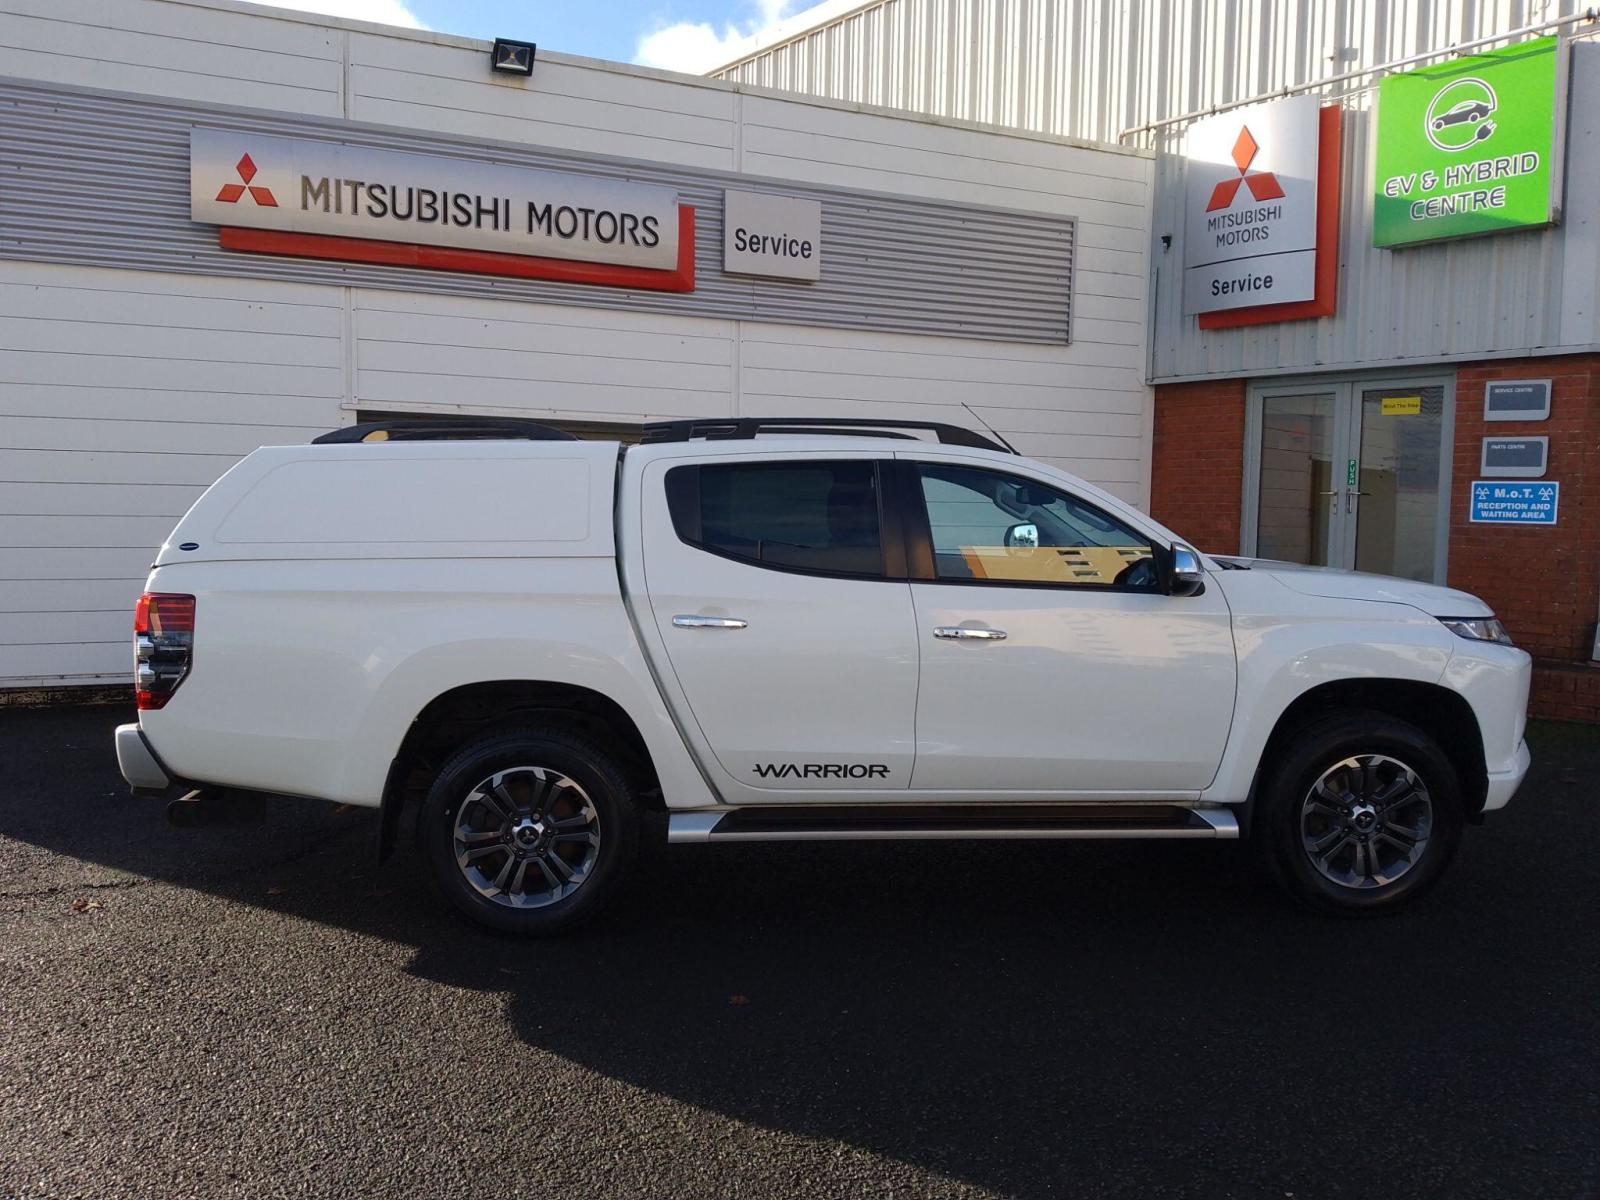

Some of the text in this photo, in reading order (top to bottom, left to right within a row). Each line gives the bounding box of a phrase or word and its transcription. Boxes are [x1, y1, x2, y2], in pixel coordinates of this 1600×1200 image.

[1384, 152, 1540, 197] EV & HYBRID
[300, 175, 660, 249] MITSUBISHI MOTORS
[1410, 186, 1506, 221] CENTRE
[1208, 205, 1282, 232] MITSUBISHI
[735, 228, 812, 259] Service
[1216, 226, 1269, 248] MOTORS
[1211, 273, 1273, 296] Service
[1494, 488, 1534, 498] M.o.T.
[1478, 502, 1551, 511] RECEPTION AND
[1521, 511, 1546, 519] AREA
[752, 763, 891, 779] WARRIOR
